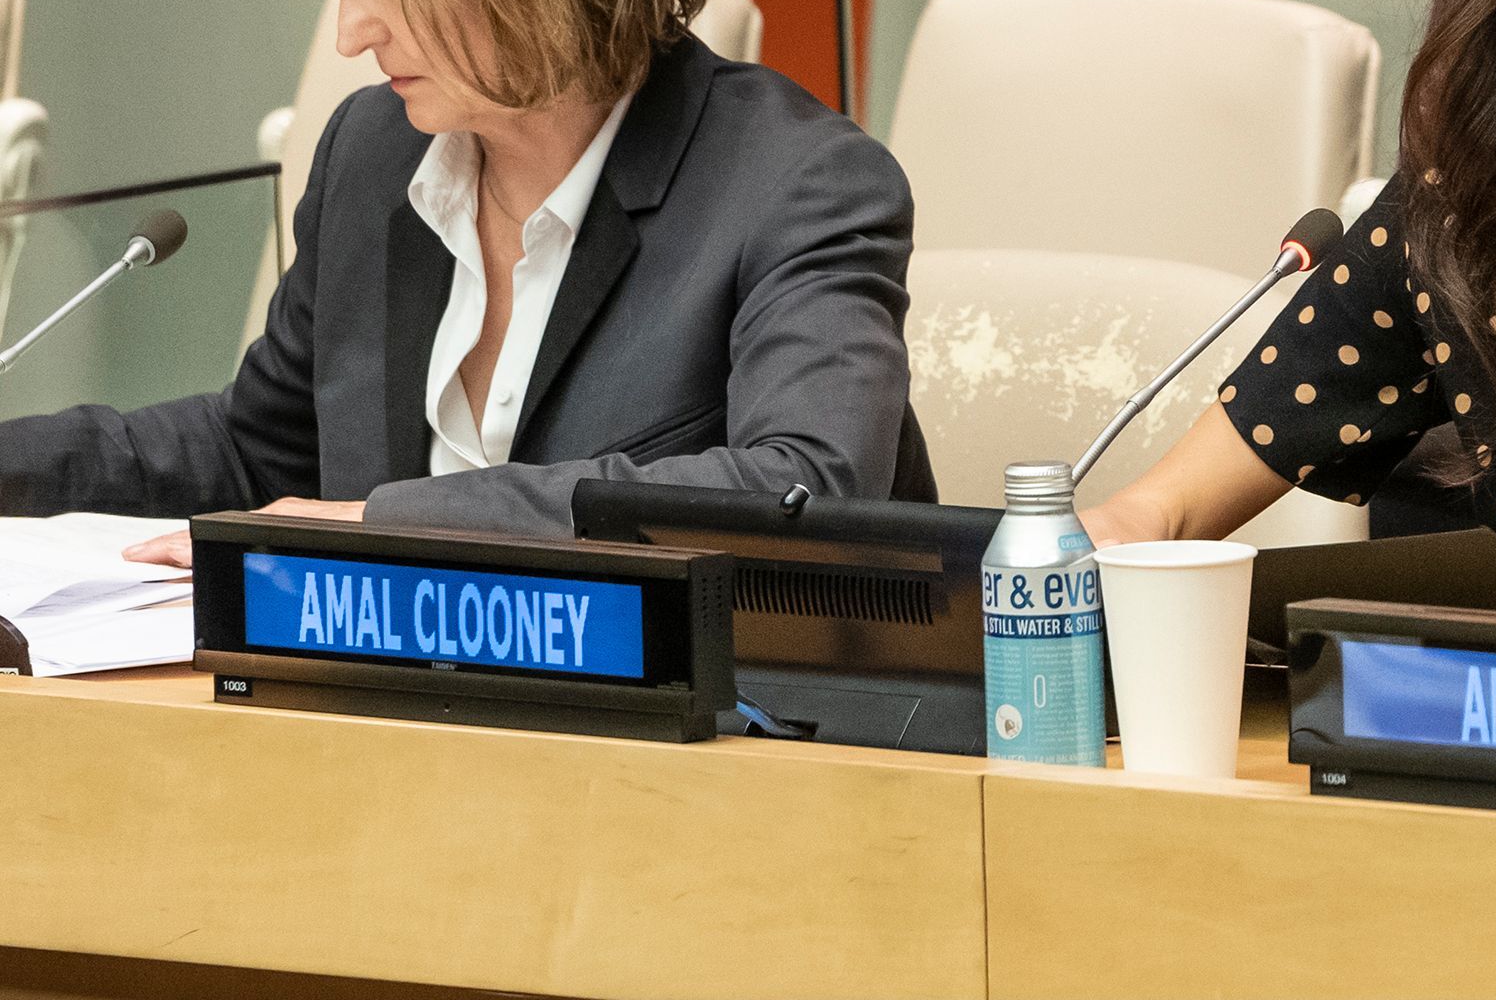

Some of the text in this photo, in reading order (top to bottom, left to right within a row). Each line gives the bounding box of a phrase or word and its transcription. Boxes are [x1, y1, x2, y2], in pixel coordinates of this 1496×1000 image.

[299, 572, 589, 667] AMAL CLOONEY
[988, 614, 1100, 636] STILL WATER & STILL
[223, 680, 247, 692] 1003
[1322, 772, 1347, 785] 1004
